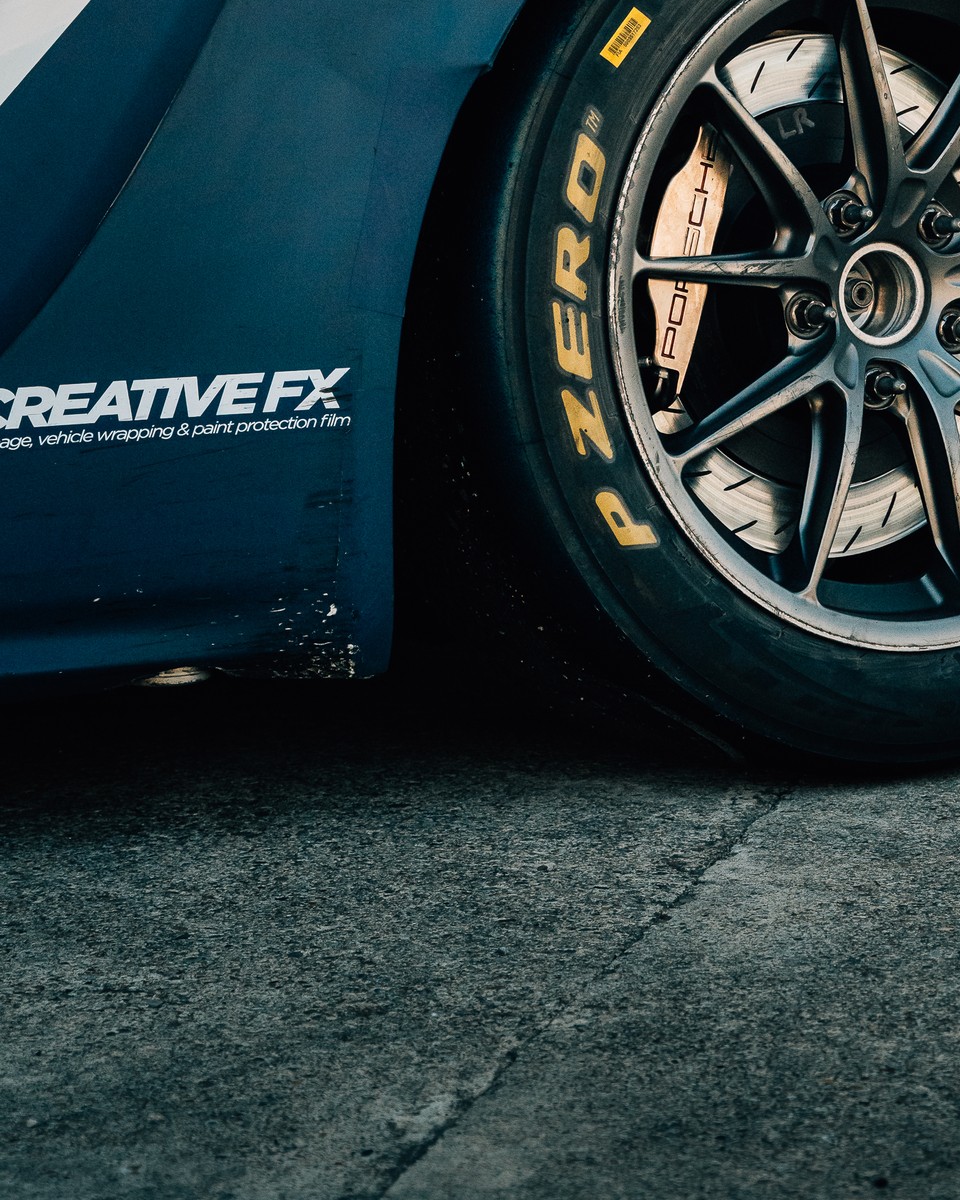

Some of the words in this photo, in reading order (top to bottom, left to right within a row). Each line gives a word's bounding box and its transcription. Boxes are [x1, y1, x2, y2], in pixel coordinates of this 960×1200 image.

[776, 107, 816, 140] LR
[552, 134, 612, 458] ZERO
[262, 367, 351, 413] FX
[38, 429, 94, 446] vehicle
[97, 424, 175, 442] wrapping
[177, 422, 190, 436] &
[191, 420, 235, 438] paint
[235, 415, 318, 435] protection
[320, 413, 351, 427] film
[595, 491, 656, 546] P
